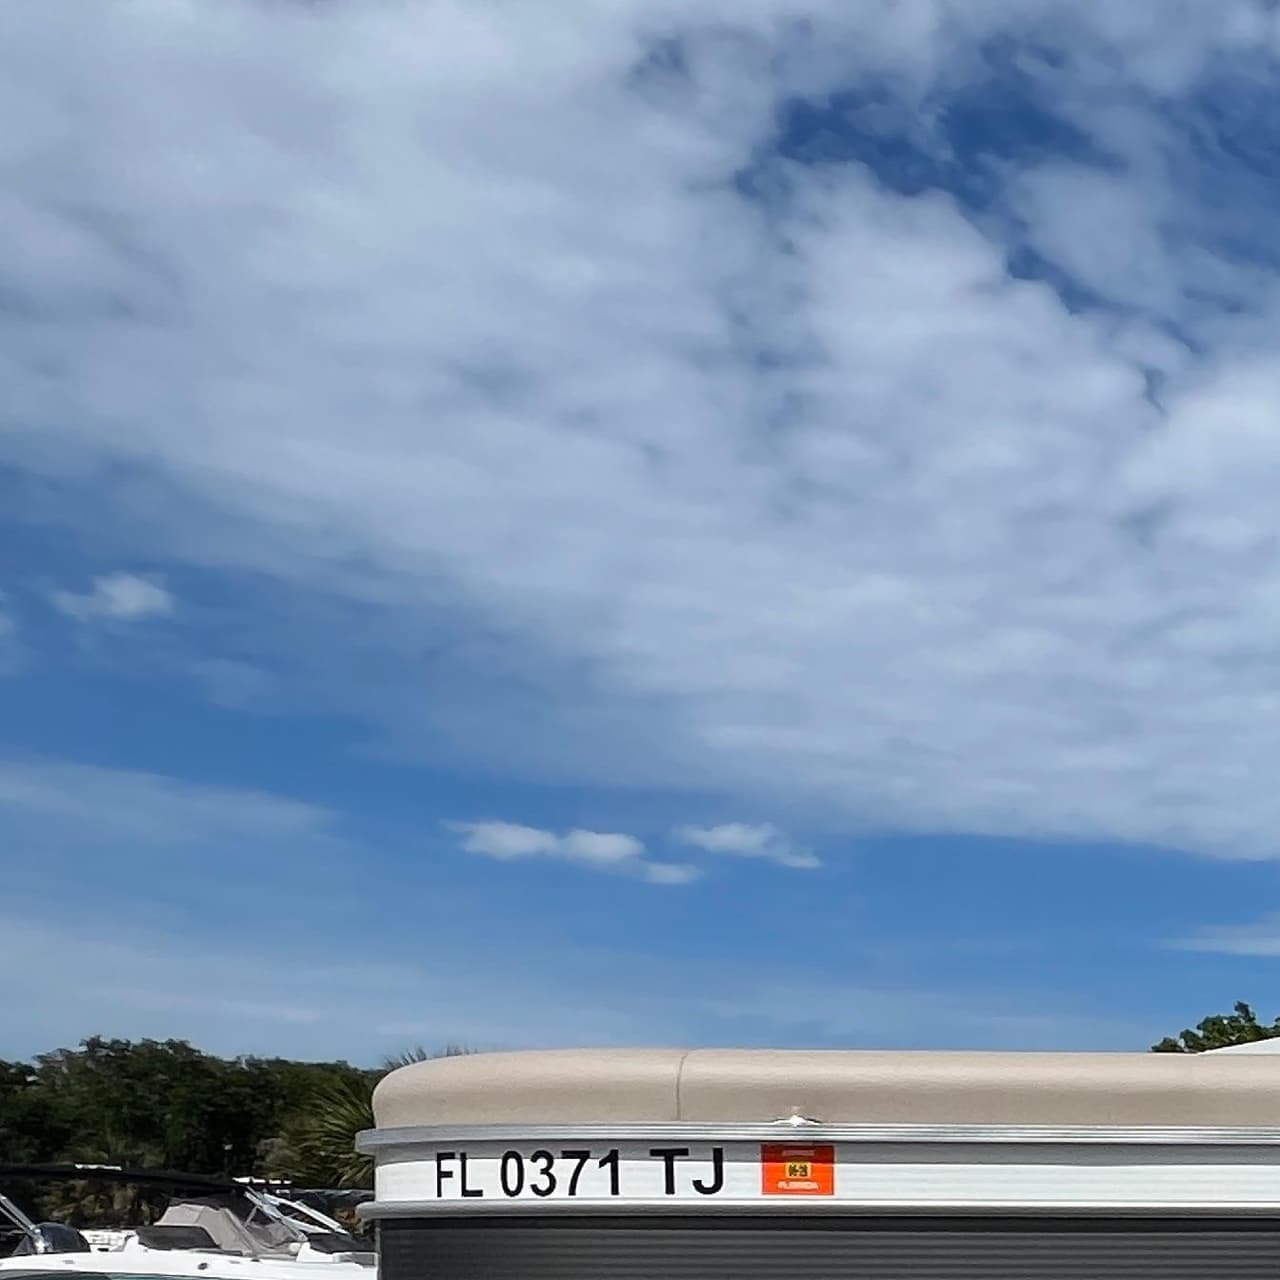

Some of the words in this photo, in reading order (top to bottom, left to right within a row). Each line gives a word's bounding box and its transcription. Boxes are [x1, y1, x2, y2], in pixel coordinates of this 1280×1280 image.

[436, 1151, 484, 1198] FL
[500, 1149, 621, 1197] 0371
[649, 1147, 724, 1196] TJ
